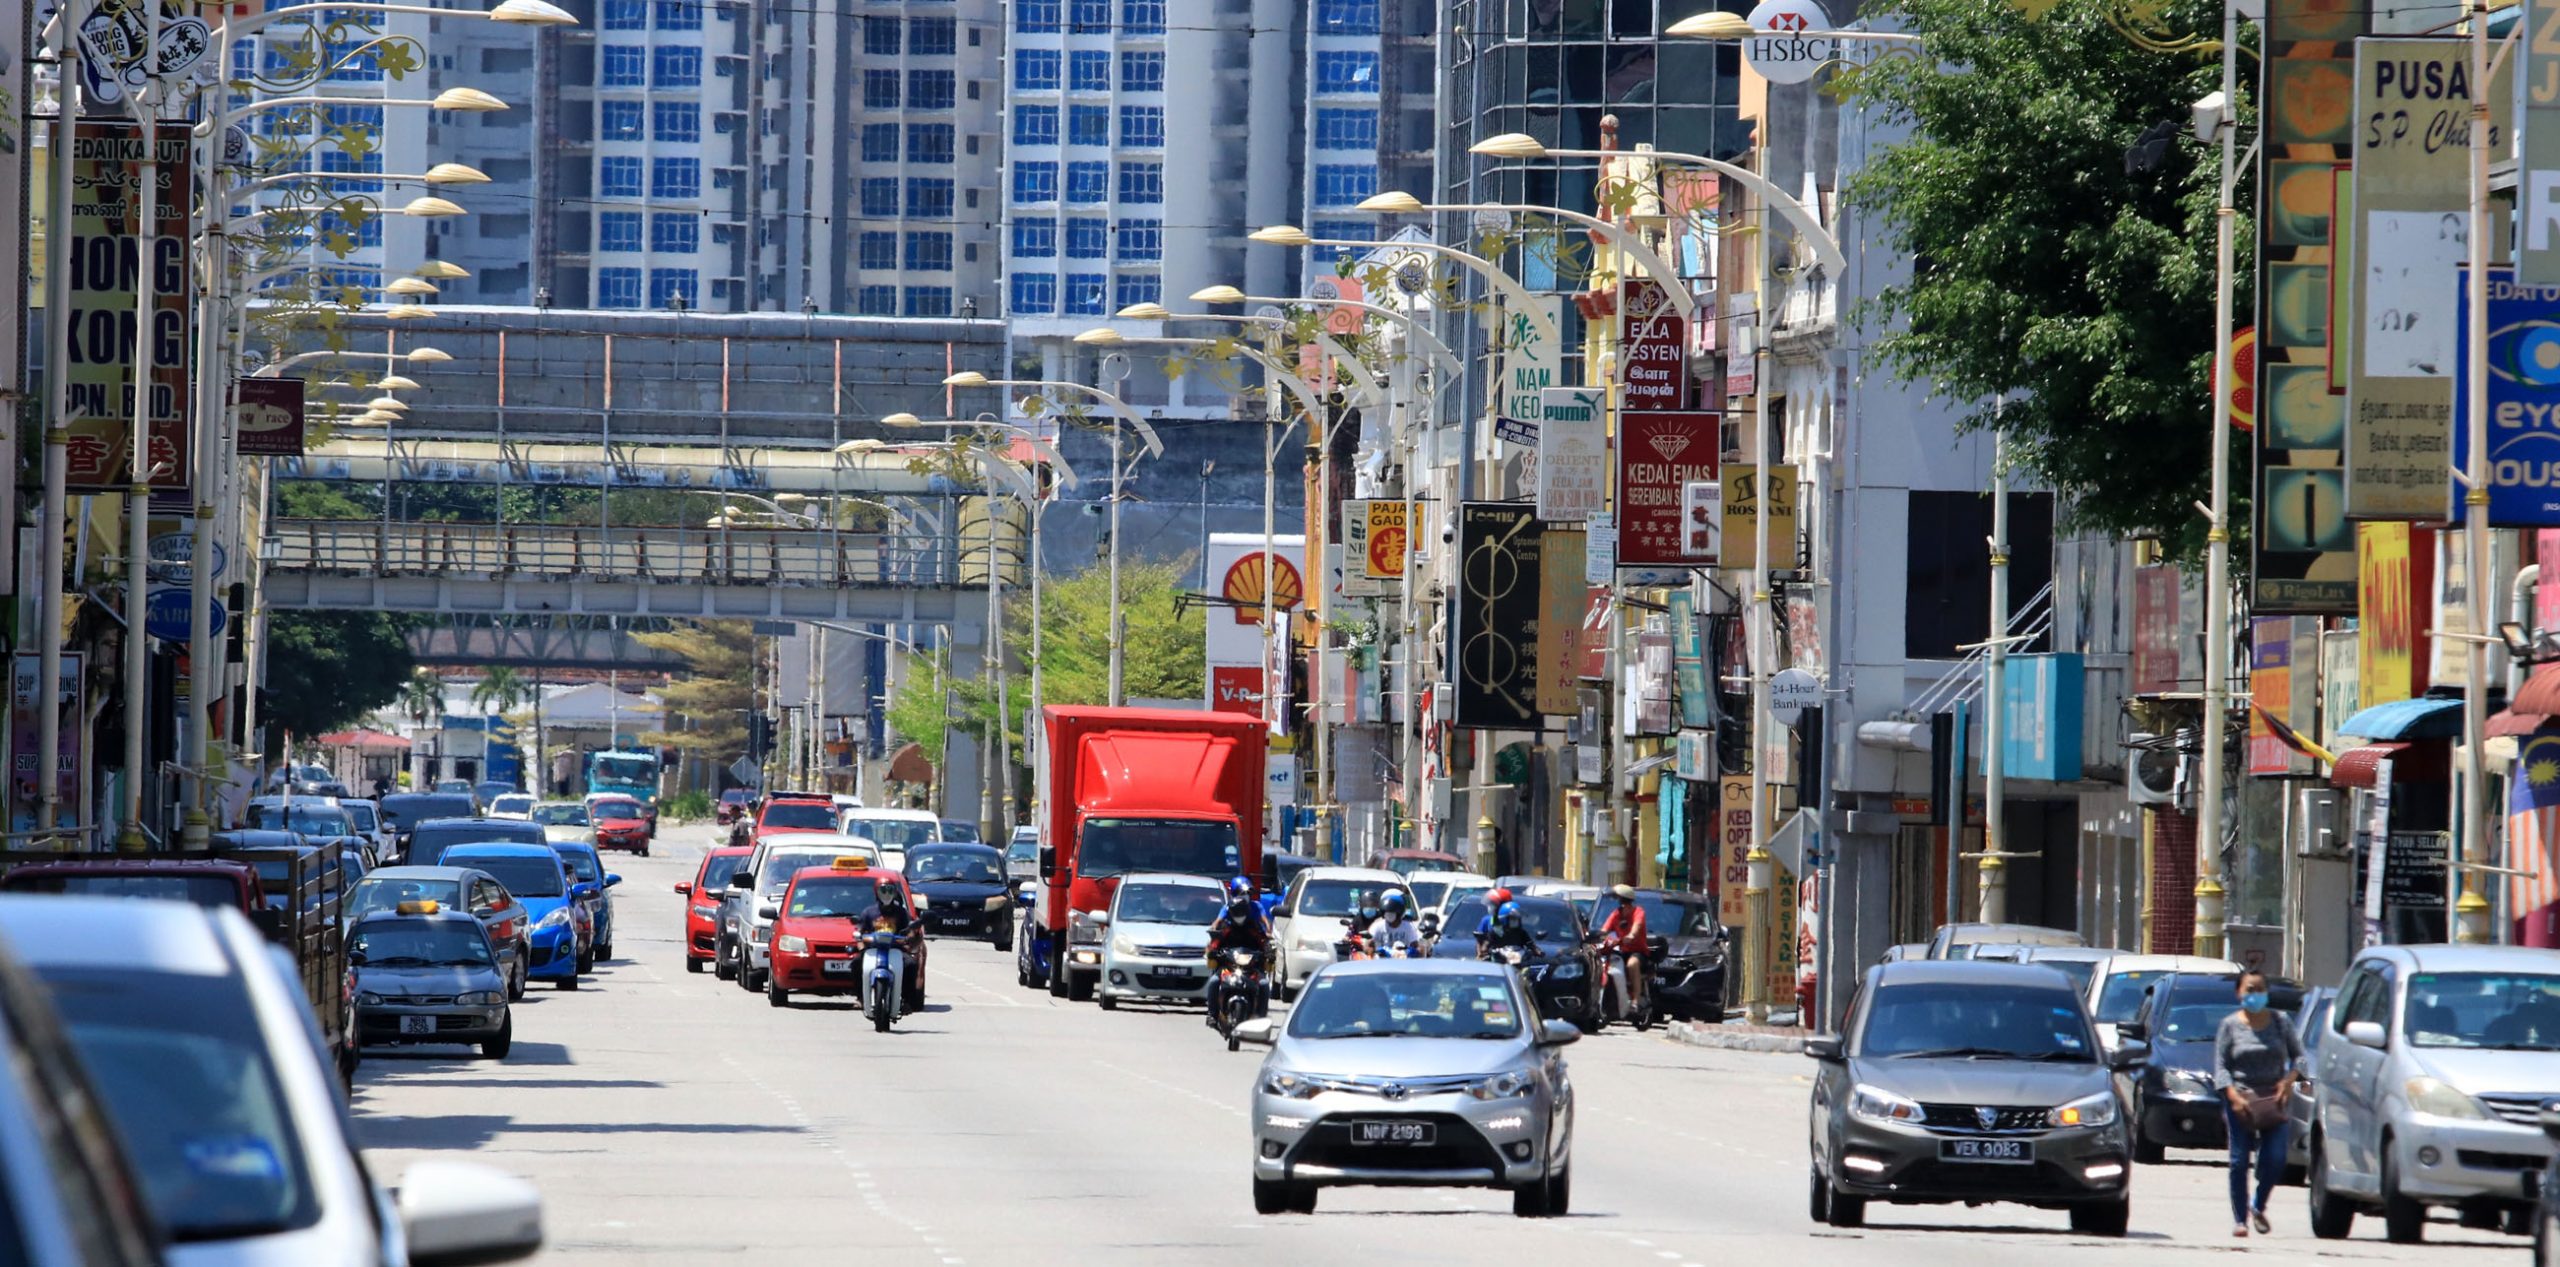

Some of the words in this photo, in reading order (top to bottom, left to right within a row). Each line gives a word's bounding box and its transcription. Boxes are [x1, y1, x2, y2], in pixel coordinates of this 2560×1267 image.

[1753, 38, 1825, 61] HSBC
[2376, 60, 2491, 100] PUSA
[1516, 367, 1551, 391] NAM
[1544, 405, 1592, 422] PUMA
[1628, 463, 1670, 485] KEDAI
[1628, 487, 1673, 507] SEREMBAN
[1640, 536, 1681, 547] 有限公
[1772, 683, 1816, 695] 24-Hour
